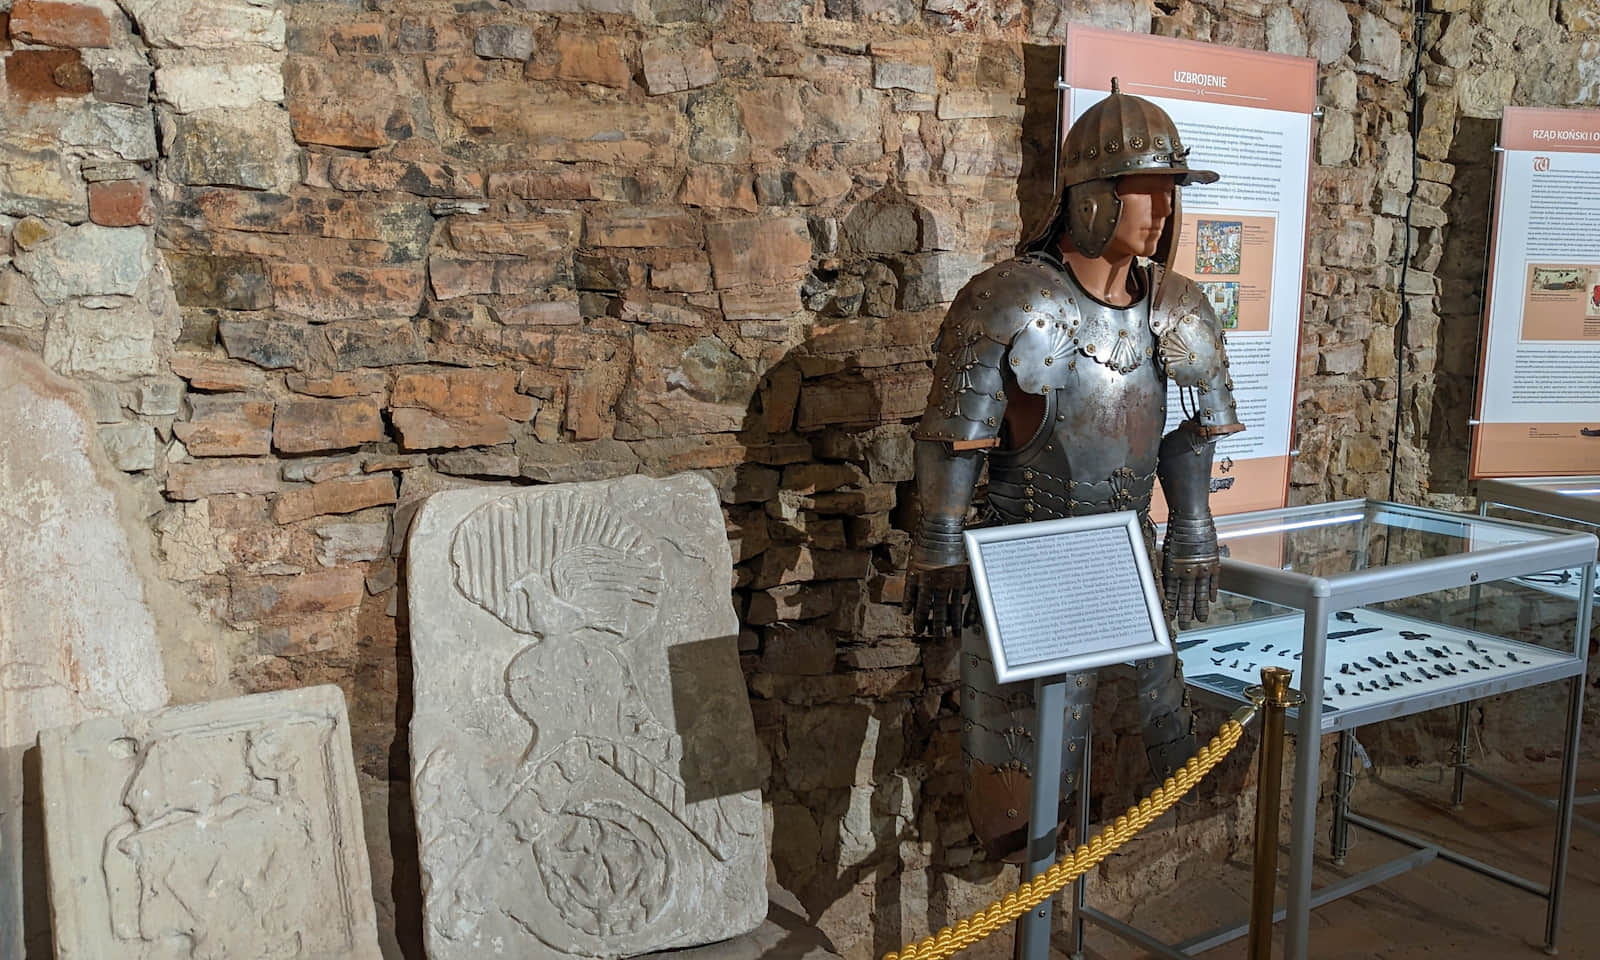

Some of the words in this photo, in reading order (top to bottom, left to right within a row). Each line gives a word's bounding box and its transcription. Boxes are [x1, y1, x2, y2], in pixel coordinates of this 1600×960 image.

[1174, 71, 1227, 88] UZBROJENIE
[1533, 130, 1556, 141] RZĄD
[1557, 129, 1588, 140] KOŃSKI
